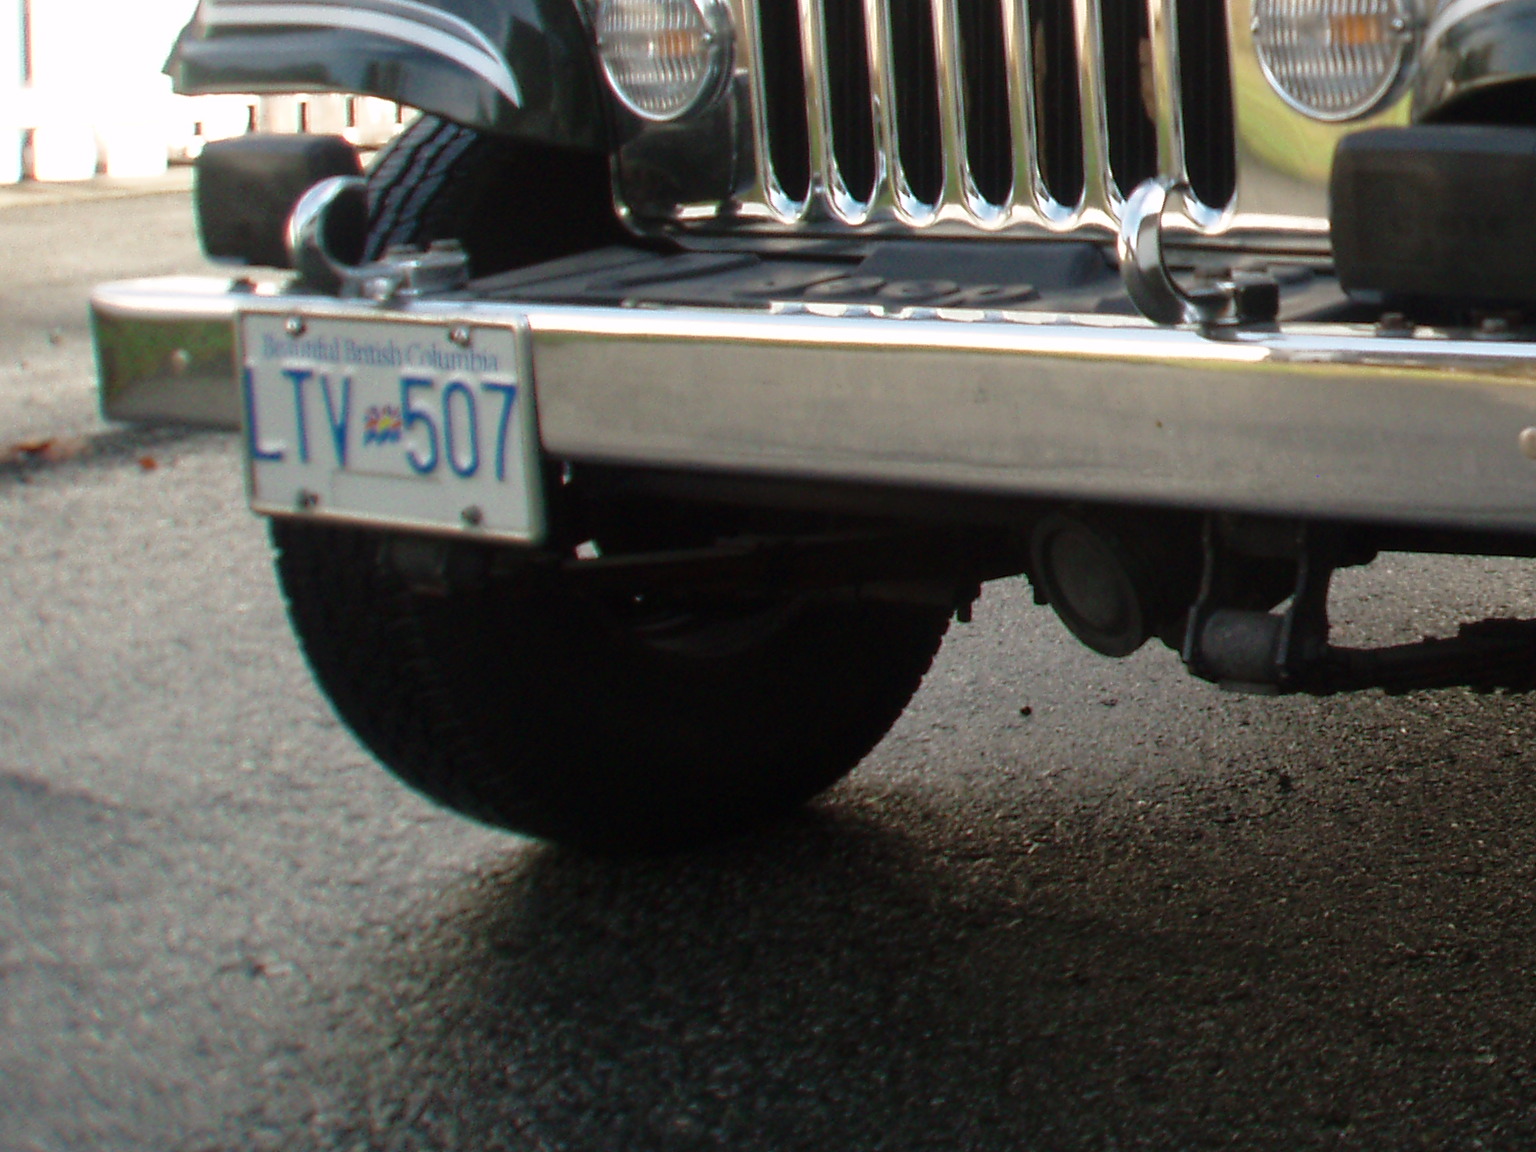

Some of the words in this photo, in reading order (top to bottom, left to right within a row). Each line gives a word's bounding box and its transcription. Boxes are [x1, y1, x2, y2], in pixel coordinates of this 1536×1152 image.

[262, 332, 341, 362] Beautiful
[344, 339, 403, 367] British
[407, 343, 499, 372] Columbia
[244, 367, 350, 467] LTV
[402, 377, 517, 481] 507
